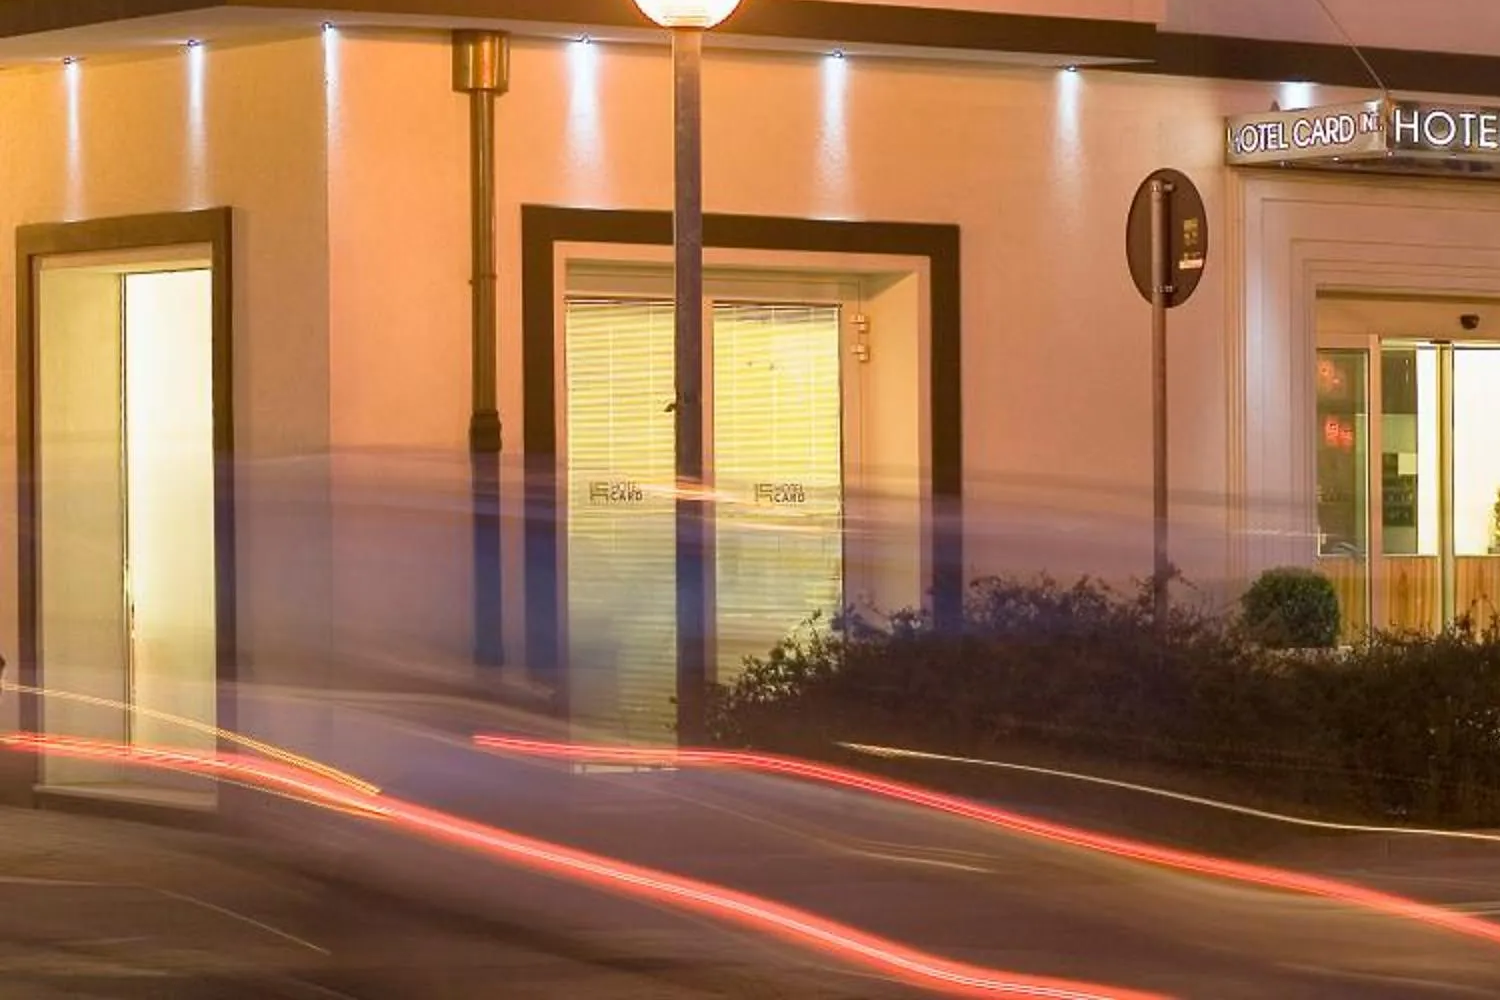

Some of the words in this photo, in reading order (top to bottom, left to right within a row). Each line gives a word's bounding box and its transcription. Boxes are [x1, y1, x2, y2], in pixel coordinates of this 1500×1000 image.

[1226, 121, 1289, 154] HOTEL
[1292, 114, 1355, 148] CARD
[610, 490, 643, 501] CARD
